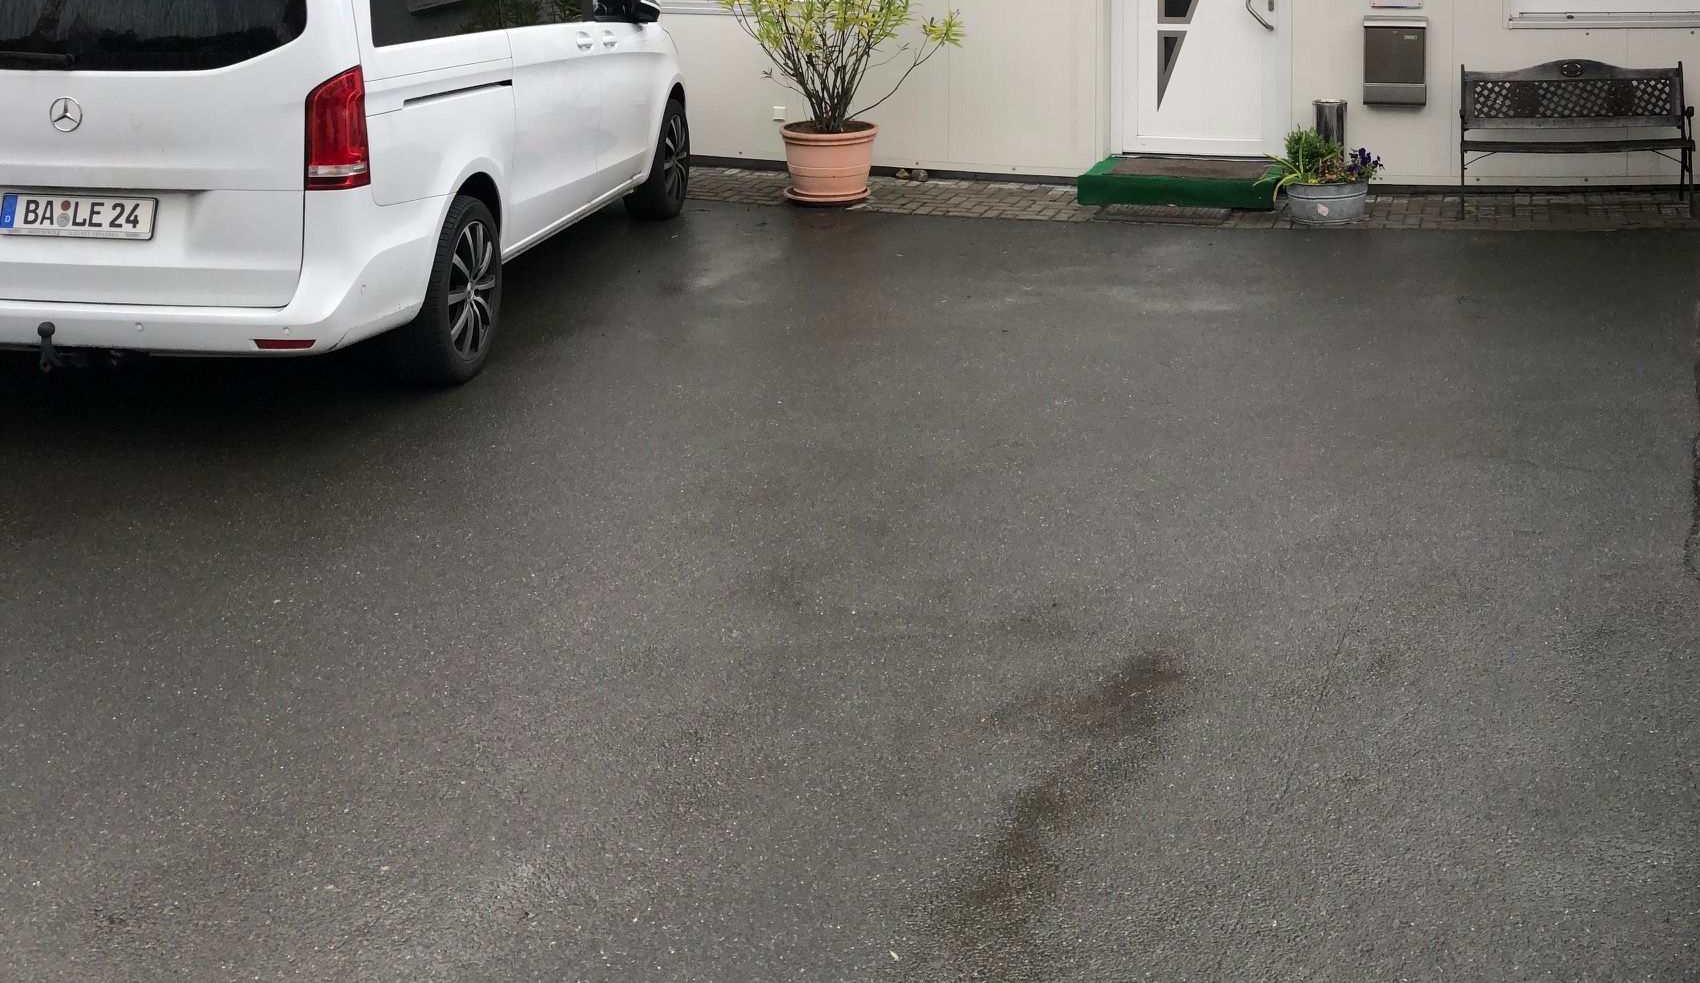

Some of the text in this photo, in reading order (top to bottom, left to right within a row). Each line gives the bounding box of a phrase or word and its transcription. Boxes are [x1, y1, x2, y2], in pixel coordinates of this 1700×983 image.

[23, 199, 140, 229] BA LE 24
